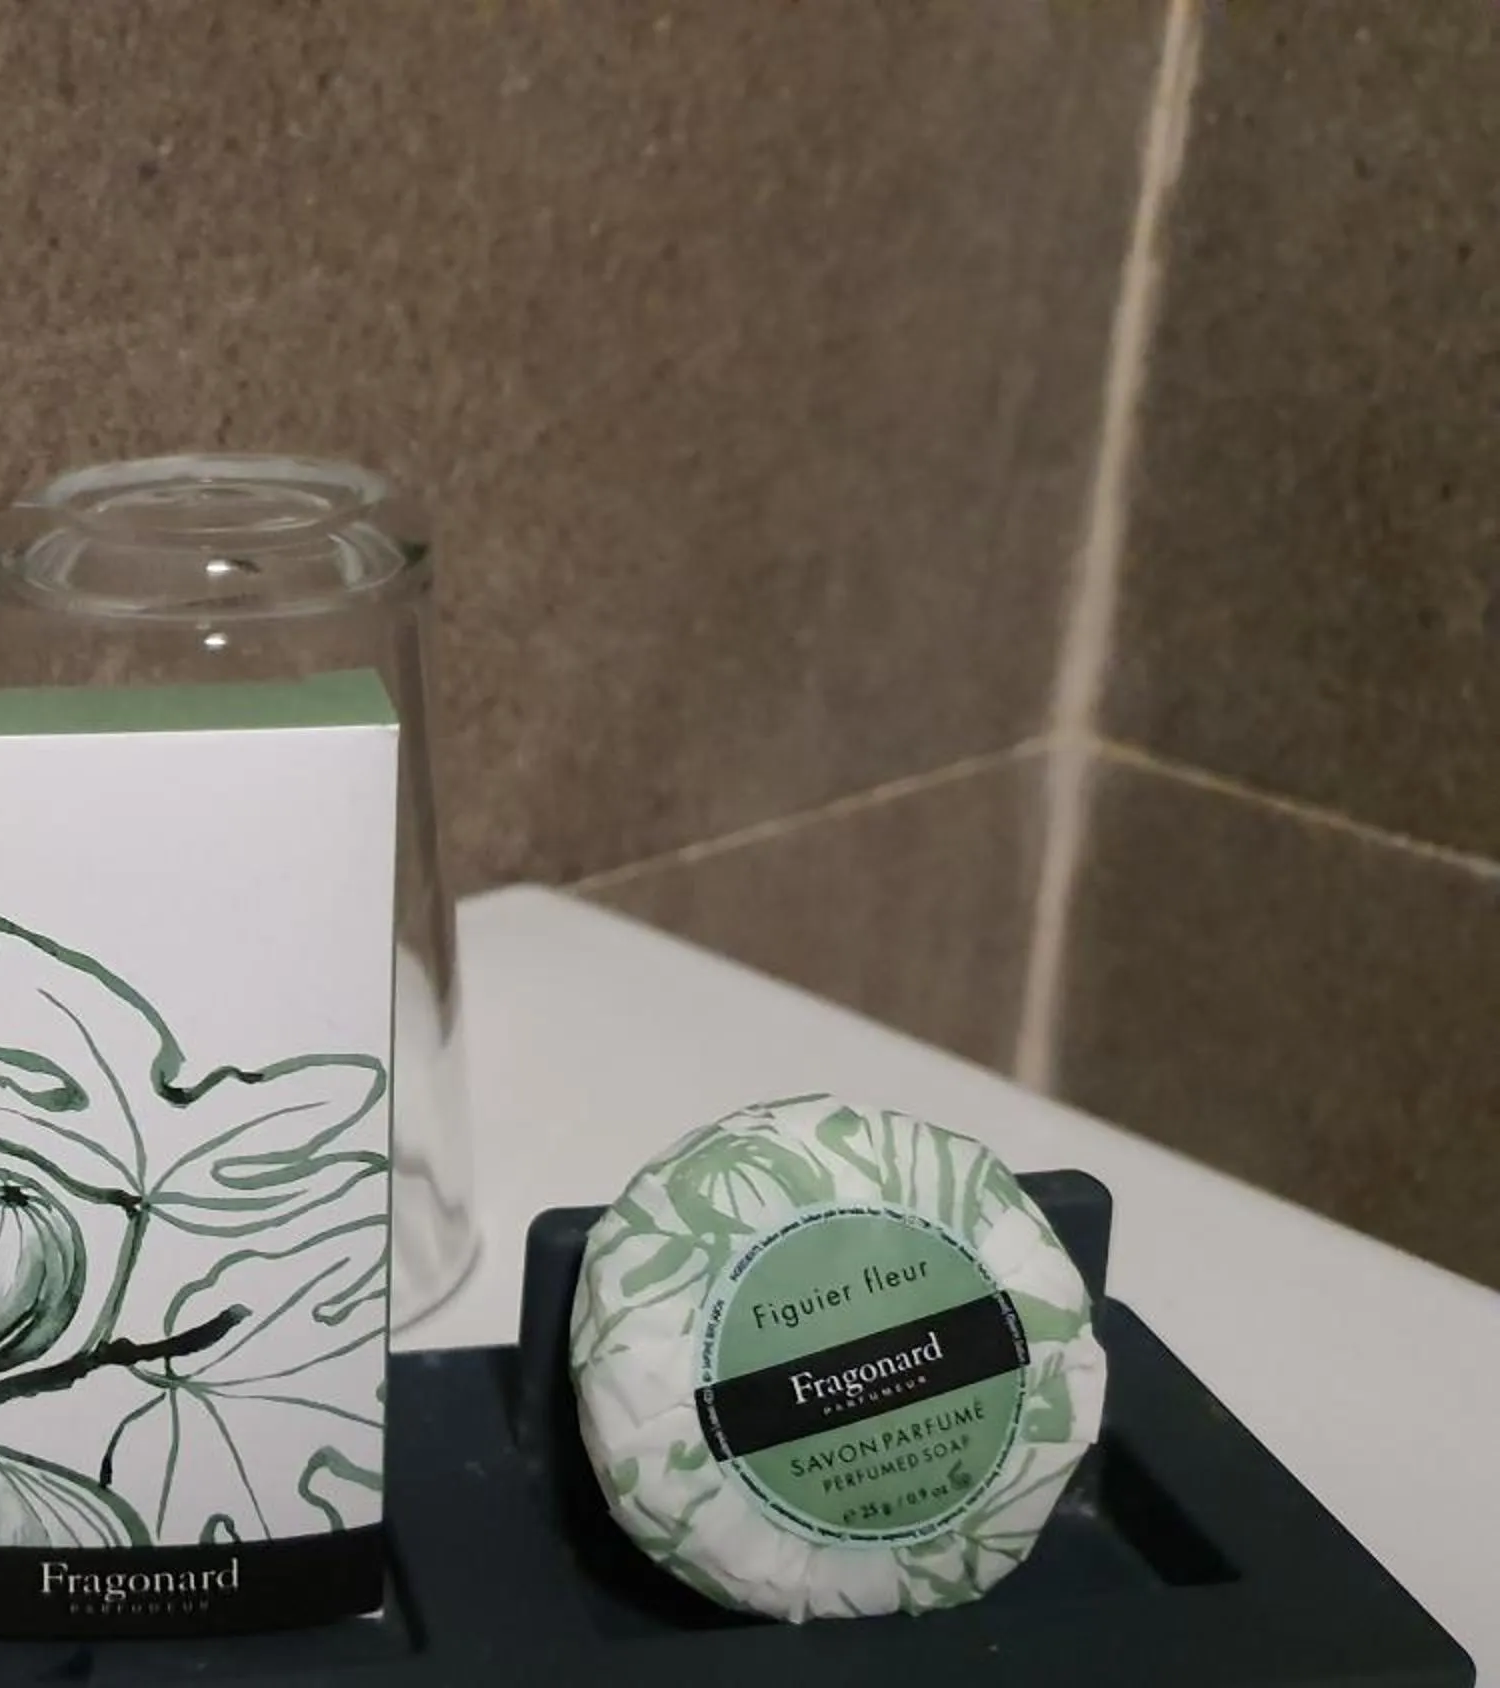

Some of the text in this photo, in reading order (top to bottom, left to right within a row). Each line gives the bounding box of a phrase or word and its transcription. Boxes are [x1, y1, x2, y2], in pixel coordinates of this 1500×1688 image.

[752, 1258, 930, 1330] Figuier fleur
[789, 1331, 944, 1406] Fragonard
[822, 1374, 928, 1417] PARFUMEUR
[789, 1437, 879, 1478] SAVON
[882, 1399, 986, 1456] PARFUMÉ
[821, 1453, 921, 1495] PERFUMED
[921, 1433, 971, 1464] SOAP
[40, 1556, 240, 1603] Fragonard
